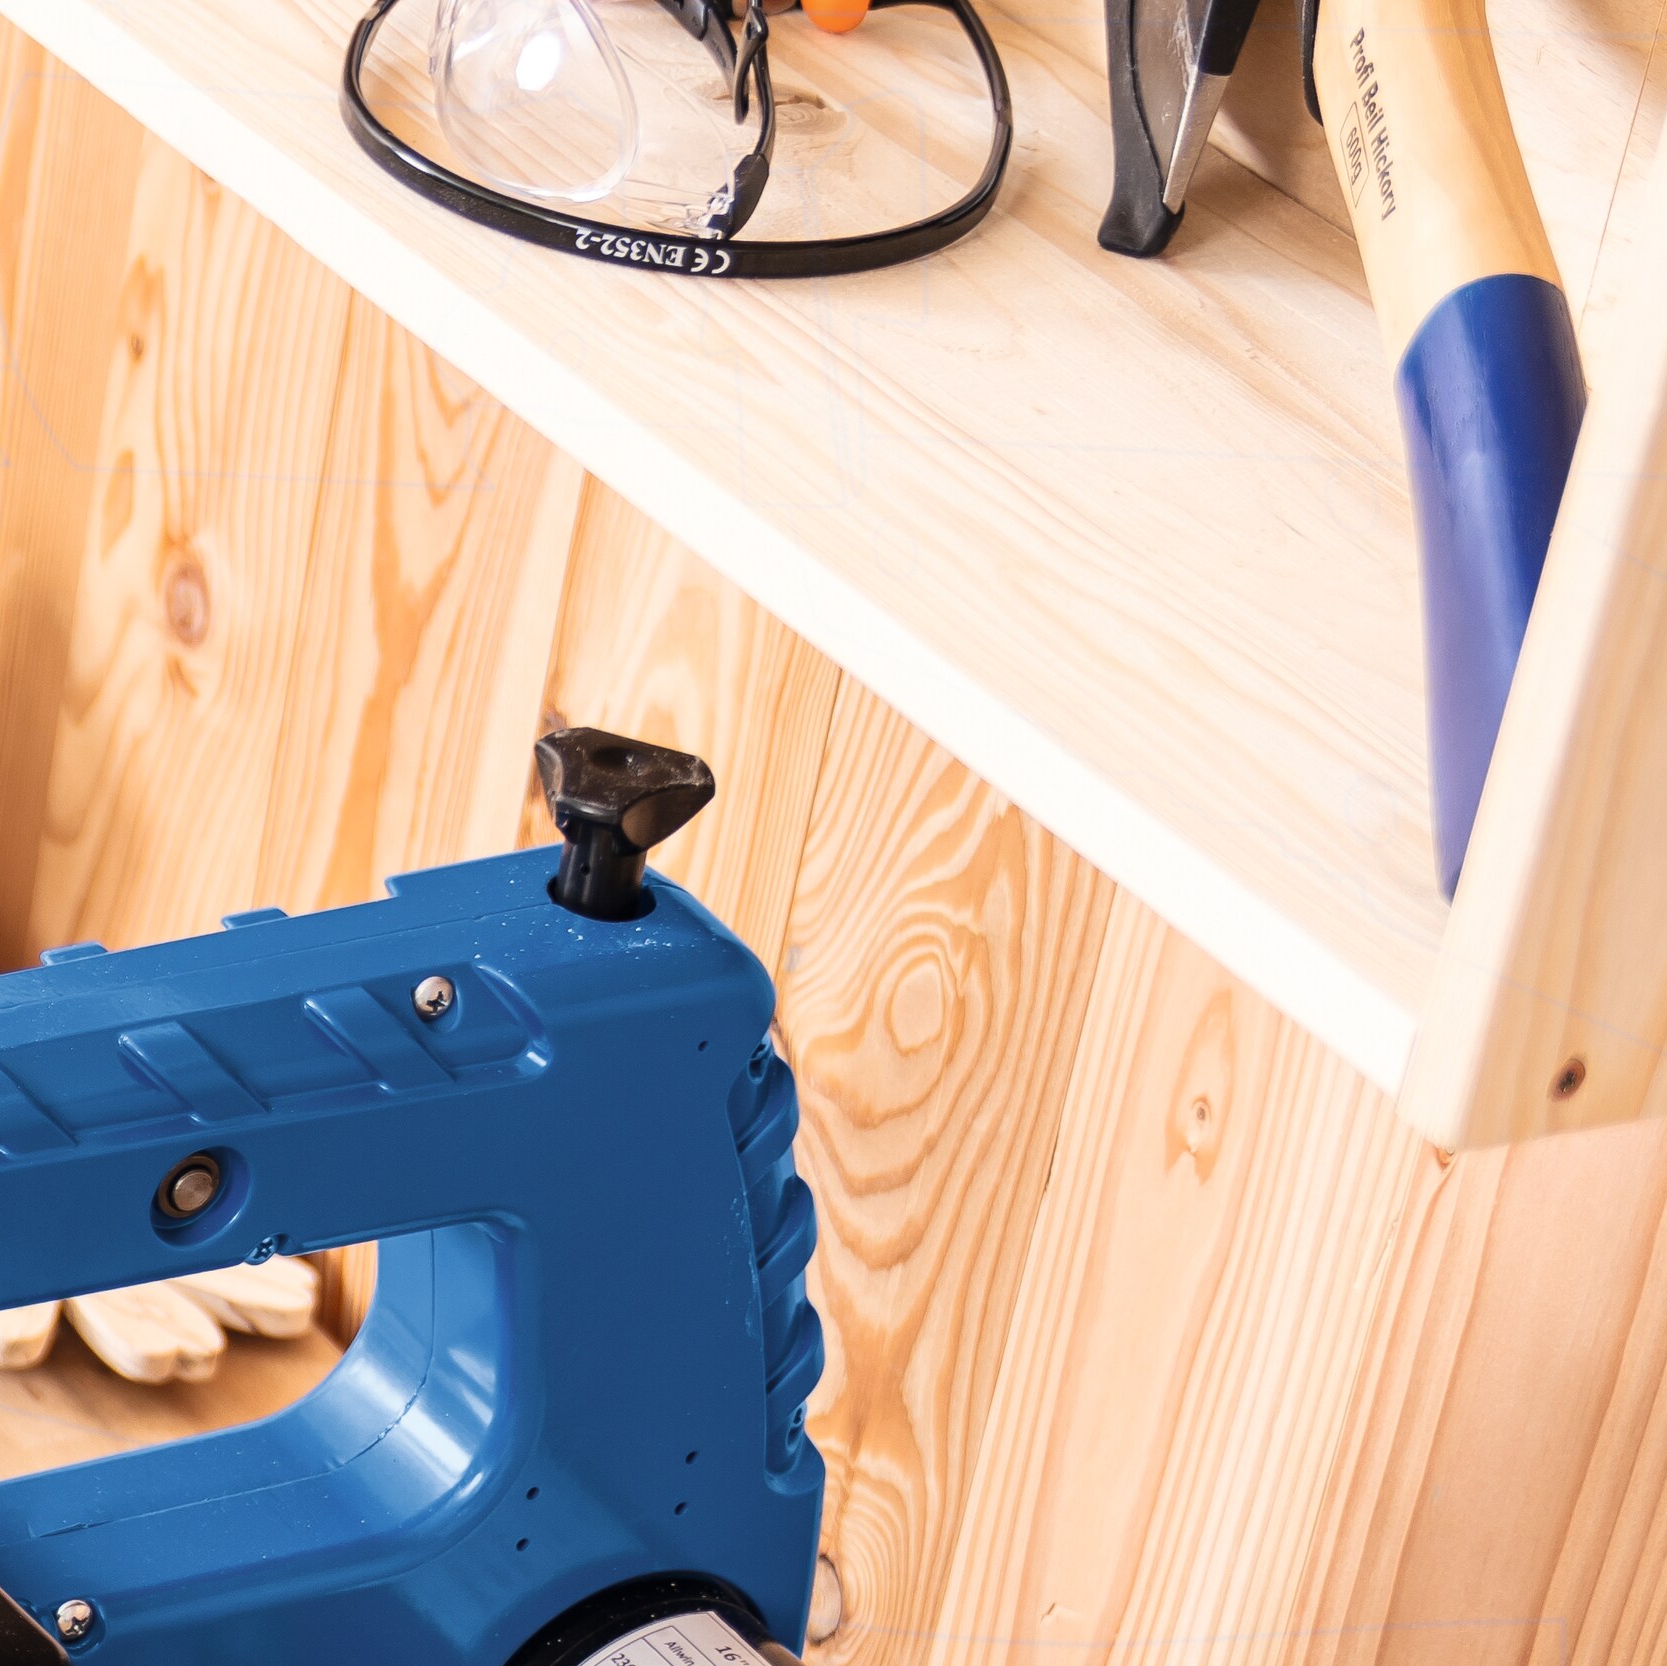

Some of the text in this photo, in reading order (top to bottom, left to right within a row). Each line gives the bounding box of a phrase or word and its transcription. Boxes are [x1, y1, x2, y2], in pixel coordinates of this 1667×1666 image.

[1350, 27, 1396, 222] Profi Beil Hickory
[1345, 126, 1362, 186] 600g
[575, 228, 687, 267] EN352-2
[664, 1641, 695, 1666] Allwin
